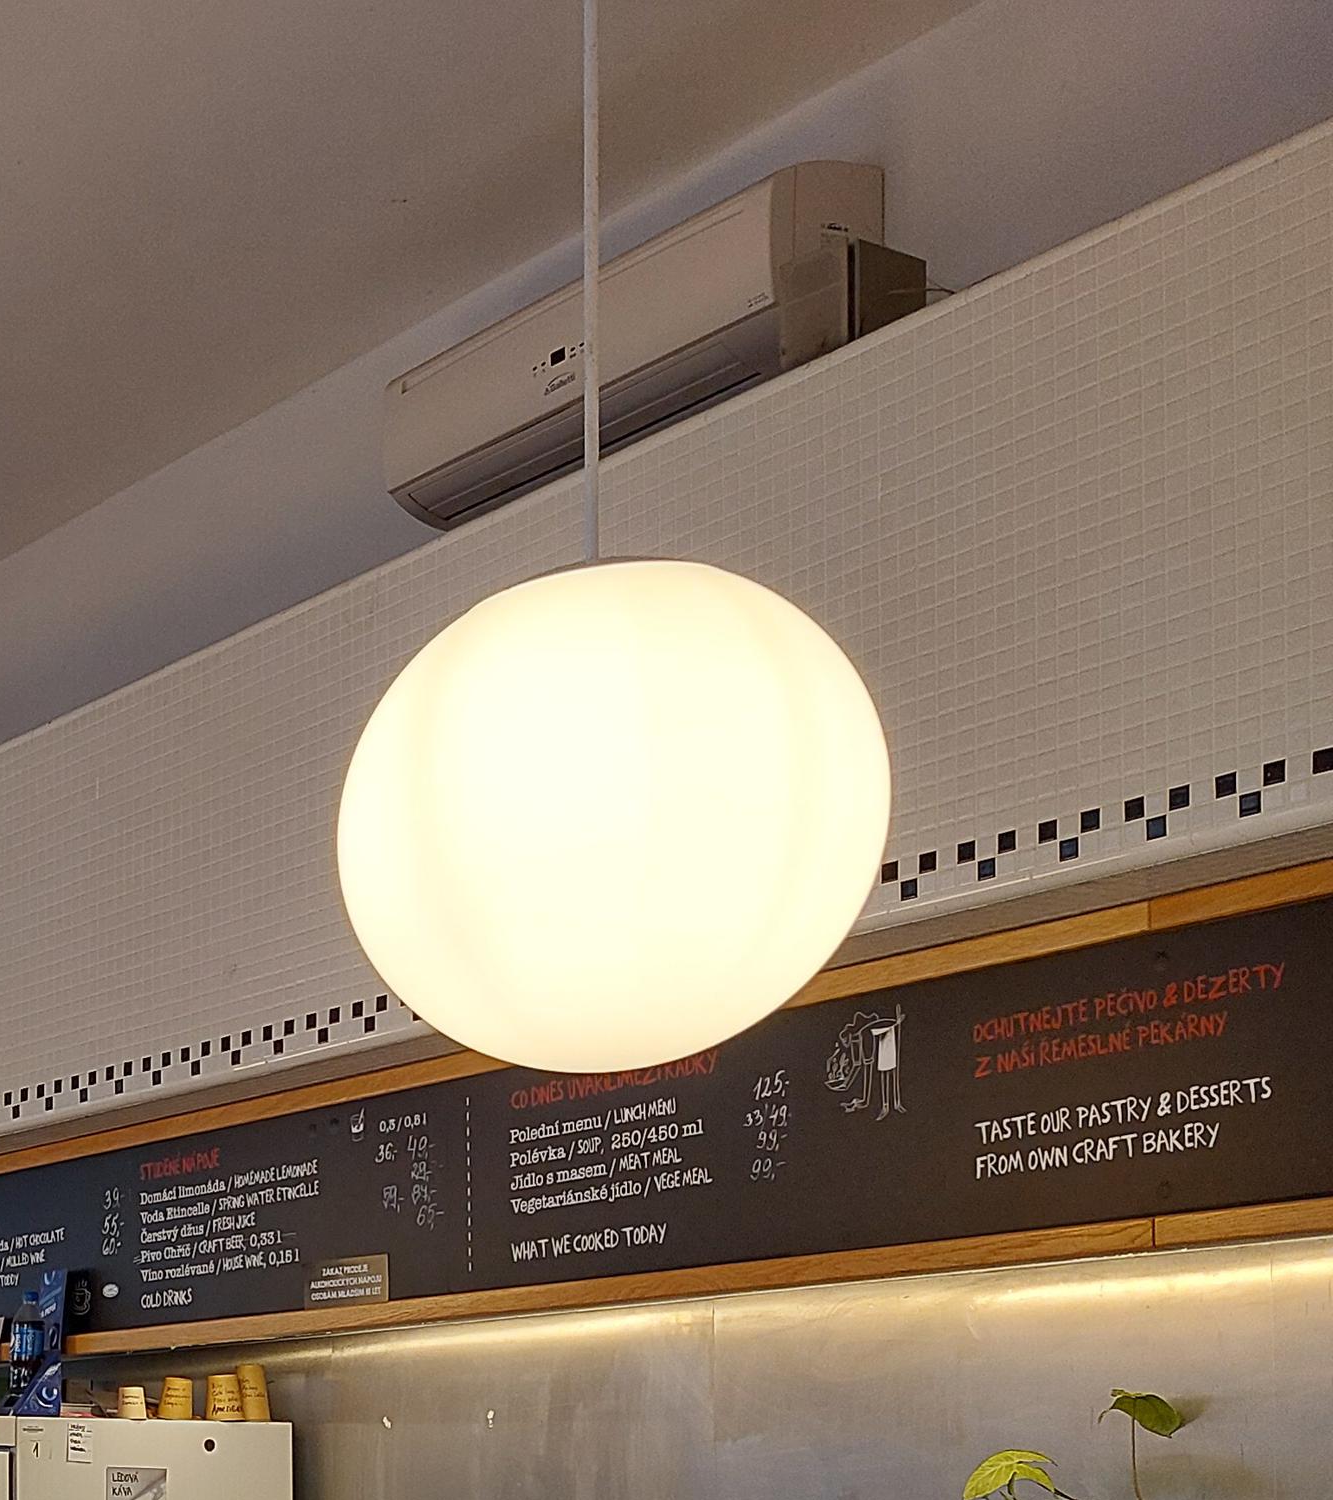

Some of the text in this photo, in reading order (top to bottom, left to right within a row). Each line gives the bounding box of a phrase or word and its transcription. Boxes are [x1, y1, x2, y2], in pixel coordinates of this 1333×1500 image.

[973, 963, 1284, 1043] OCHUTNEJTE PEČIVO & DEZERTY
[974, 1056, 992, 1079] Z
[1138, 1011, 1228, 1047] PEKÁRNY
[531, 1080, 564, 1104] DNES
[509, 1097, 676, 1144] Polední menu LUNCH MENU
[974, 1077, 1272, 1145] TASTE OUR PASTRY & DESSERTS
[510, 1119, 703, 1168] Polévka SOUP, 250/450 ml
[976, 1123, 1220, 1179] FROM OWN CRAFT BAKERY
[510, 1148, 682, 1190] Jídlo s masem MEAT MEAL
[139, 1191, 177, 1205] Domácí
[178, 1180, 226, 1198] limonáda
[140, 1211, 164, 1224] Voda
[166, 1202, 210, 1219] Etincelle
[246, 1189, 274, 1207] WATER
[510, 1168, 713, 1214] Vegetariánské jídlo VEGE MEAL
[140, 1228, 179, 1244] Čerstvý
[180, 1222, 204, 1237] džus
[212, 1217, 235, 1233] FRESH
[140, 1251, 161, 1263] Pivo
[198, 1238, 224, 1254] CRAFT
[249, 1233, 275, 1248] 0,33
[511, 1223, 667, 1262] WHAT WE COOKED TODAY
[140, 1269, 163, 1282] Víno
[165, 1260, 214, 1278] rozlévané
[141, 1288, 192, 1309] COLD DRINKS
[112, 1471, 138, 1483] LEDOVÁ
[112, 1485, 132, 1496] KÁVA
